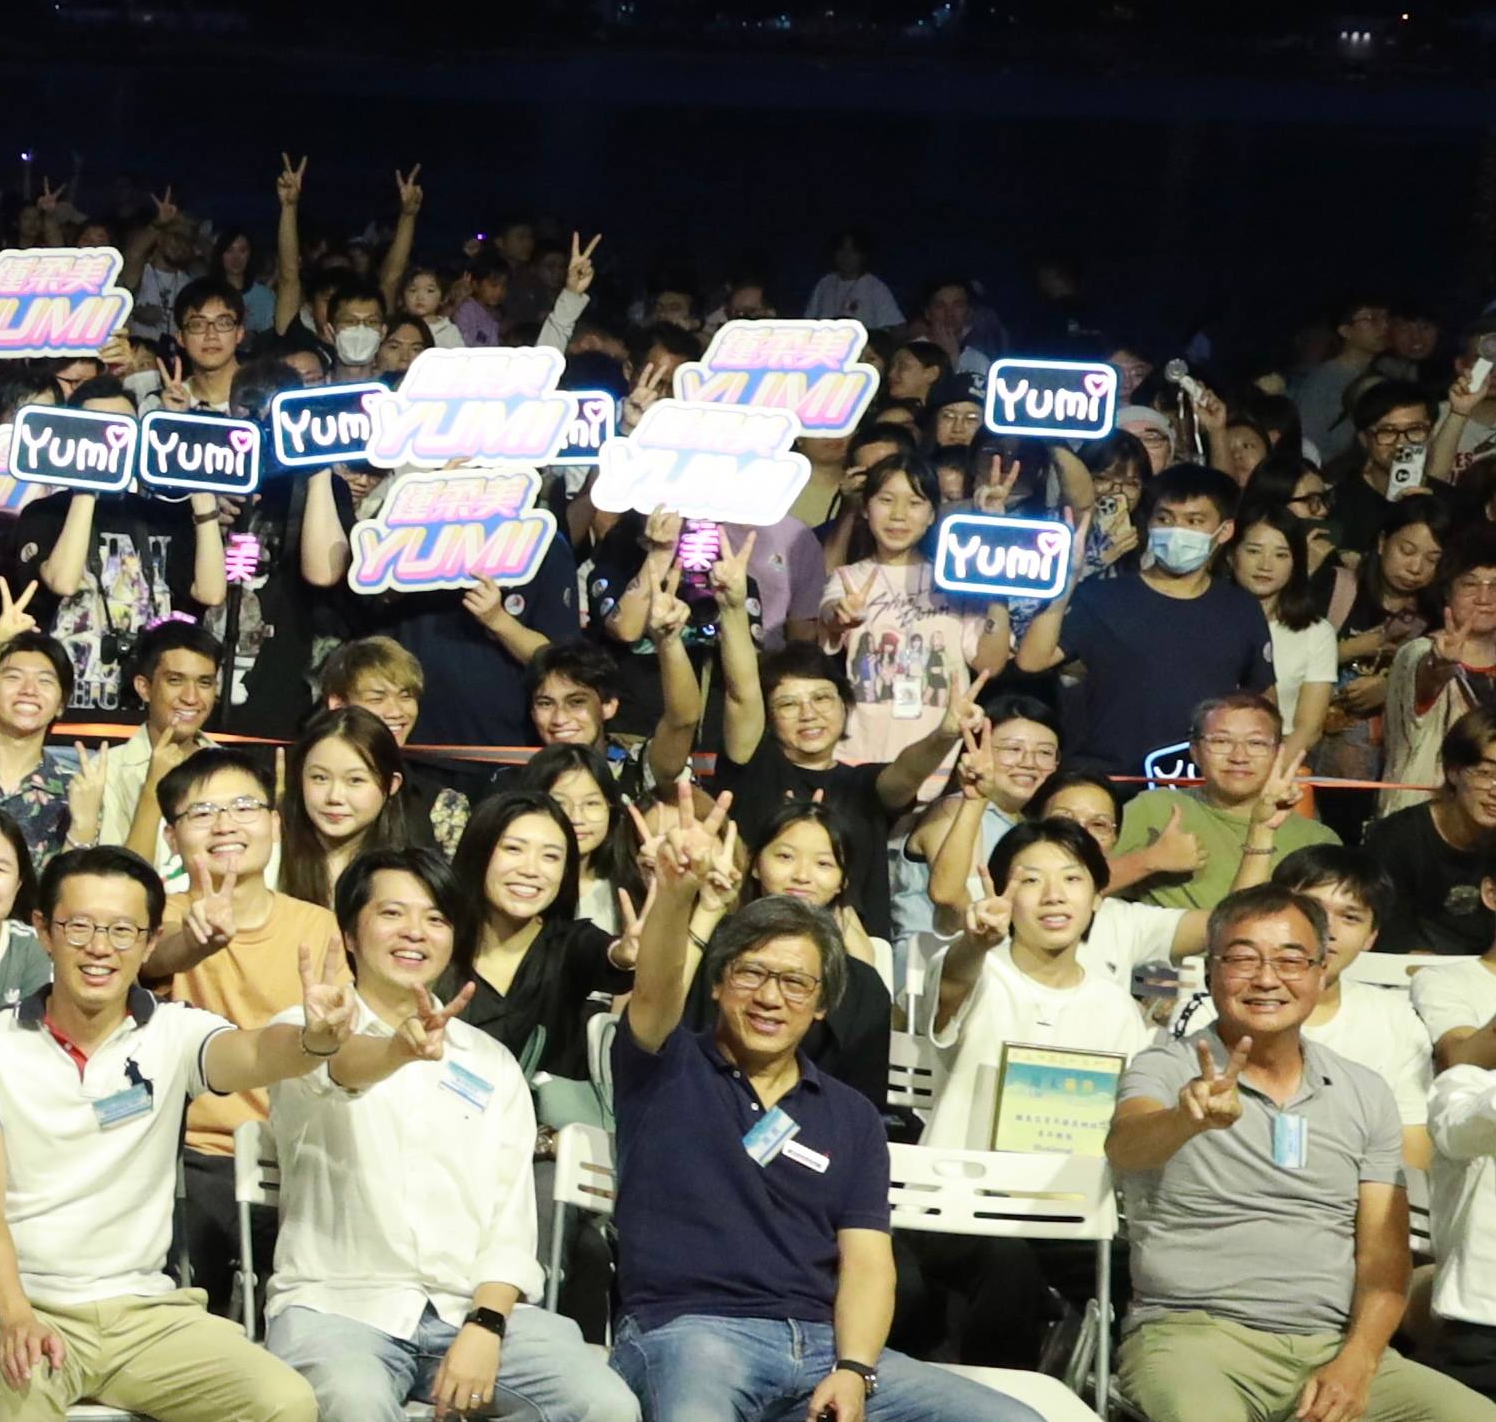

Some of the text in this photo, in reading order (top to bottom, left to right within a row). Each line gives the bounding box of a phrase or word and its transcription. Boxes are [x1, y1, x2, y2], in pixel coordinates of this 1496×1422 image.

[996, 373, 1111, 423] Yumi
[21, 423, 130, 474] Yumi
[149, 428, 254, 477] Yumi
[280, 405, 371, 453] Yum
[376, 399, 569, 460] YUMI
[386, 475, 532, 527] 鍾柔美
[357, 519, 549, 584] YUMI
[947, 531, 1064, 582] Yumi
